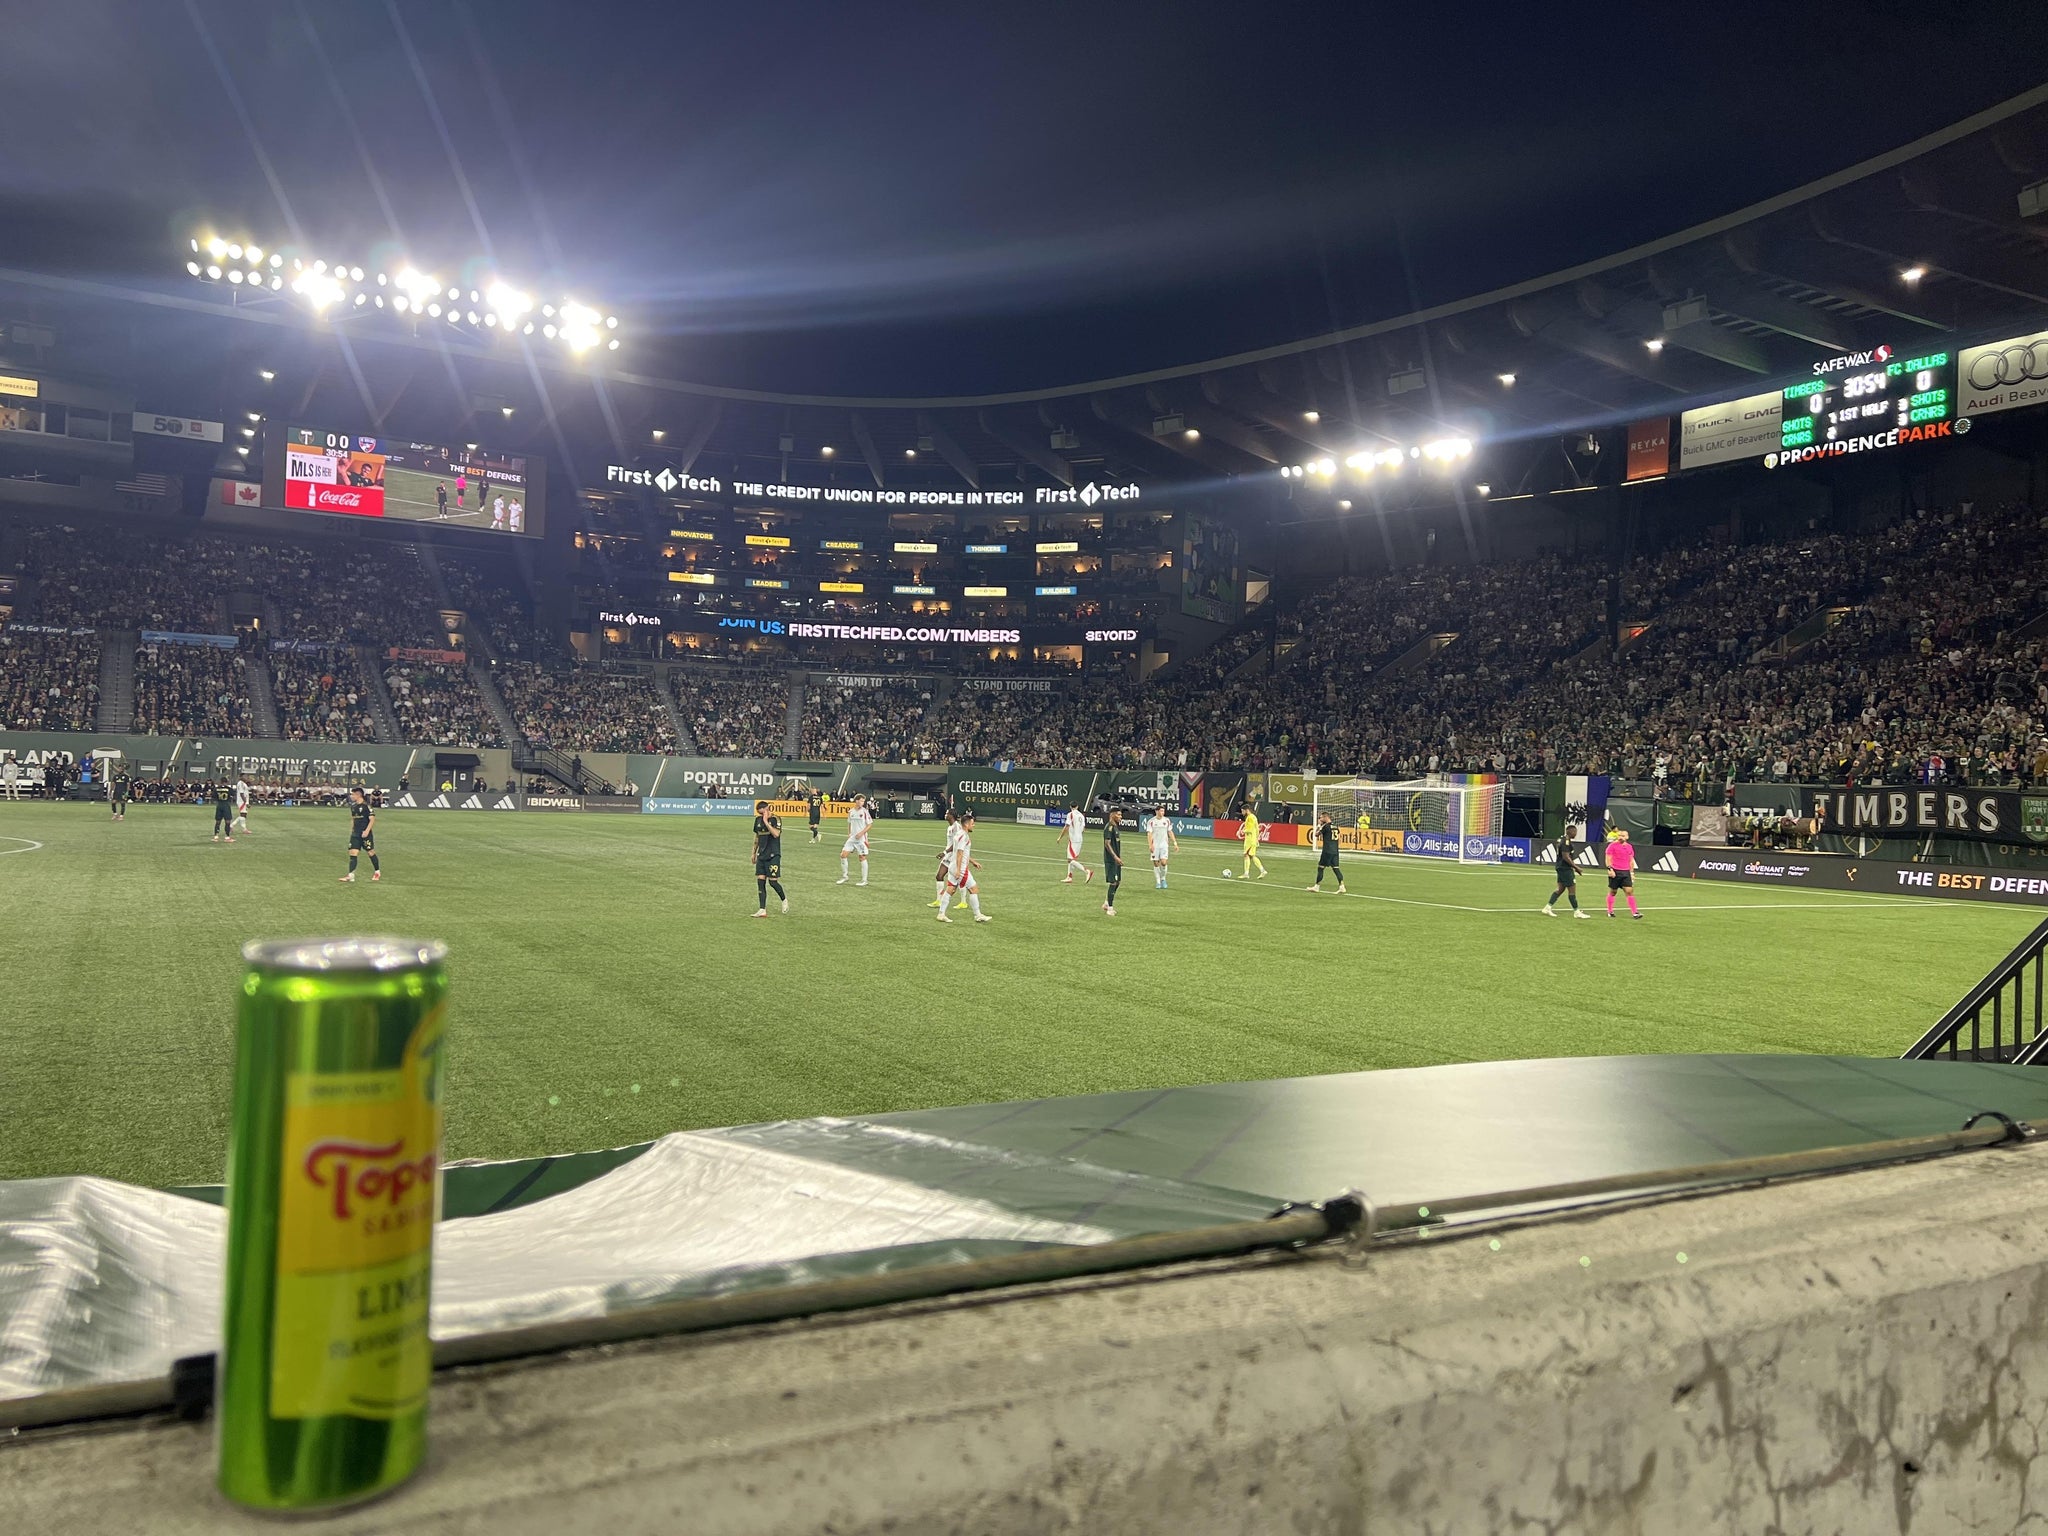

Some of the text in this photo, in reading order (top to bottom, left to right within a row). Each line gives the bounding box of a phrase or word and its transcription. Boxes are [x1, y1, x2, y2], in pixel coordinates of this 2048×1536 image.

[1813, 350, 1873, 375] SAFEWAY
[1886, 352, 1948, 377] FC DALLAS
[1783, 380, 1826, 399] TIMBERS
[1910, 390, 1946, 407] SHOTS
[1967, 394, 2003, 410] Audi
[1744, 406, 1781, 420] GMC
[1839, 406, 1859, 421] 1ST
[1910, 405, 1946, 422] CRNRS
[1697, 416, 1734, 429] BUICK
[1782, 416, 1813, 433] SHOTS
[326, 433, 336, 447] 0
[339, 435, 349, 449] 0
[1631, 437, 1666, 451] REYKA
[1683, 430, 1781, 456] Buick GMC of Beaverton
[325, 448, 348, 458] 30:54
[291, 459, 314, 477] MLS
[449, 464, 522, 483] THE BEST DEFENSE
[607, 465, 721, 493] First Tech
[733, 482, 1024, 505] THE CREDIT UNION FOR PEOPLE IN TECH
[1035, 482, 1140, 504] First Tech
[670, 530, 714, 540] INNOVATORS
[825, 541, 859, 550] CREATORS
[752, 579, 782, 588] LEADERS
[894, 586, 934, 595] DISRUPTORS
[599, 612, 661, 626] First Tech
[41, 626, 68, 634] Time!
[759, 620, 786, 635] US:
[788, 623, 1021, 643] FIRSTTECHFED.COM/TIMBERS
[973, 680, 1051, 691] STAND TOGETHER
[333, 760, 377, 775] YEARS
[683, 770, 774, 786] PORTLAND
[702, 785, 755, 796] TBERS
[959, 780, 1068, 797] CELEBRATING 50 YEARS
[530, 797, 580, 808] BIDWELL
[965, 795, 977, 803] OF
[980, 796, 1017, 804] SOCCER
[829, 801, 852, 815] Tire
[1813, 790, 1999, 834] TIMBERS
[1085, 816, 1104, 825] TOYOTA
[1371, 831, 1397, 846] Tire
[1422, 838, 1459, 853] Allstate
[1484, 843, 1524, 858] Allstate
[1999, 844, 2020, 855] OF
[1698, 859, 1737, 872] Acronis
[1744, 864, 1785, 874] COVENANT
[1897, 870, 2048, 895] THE BEST DEFEN
[358, 1268, 431, 1322] LIM
